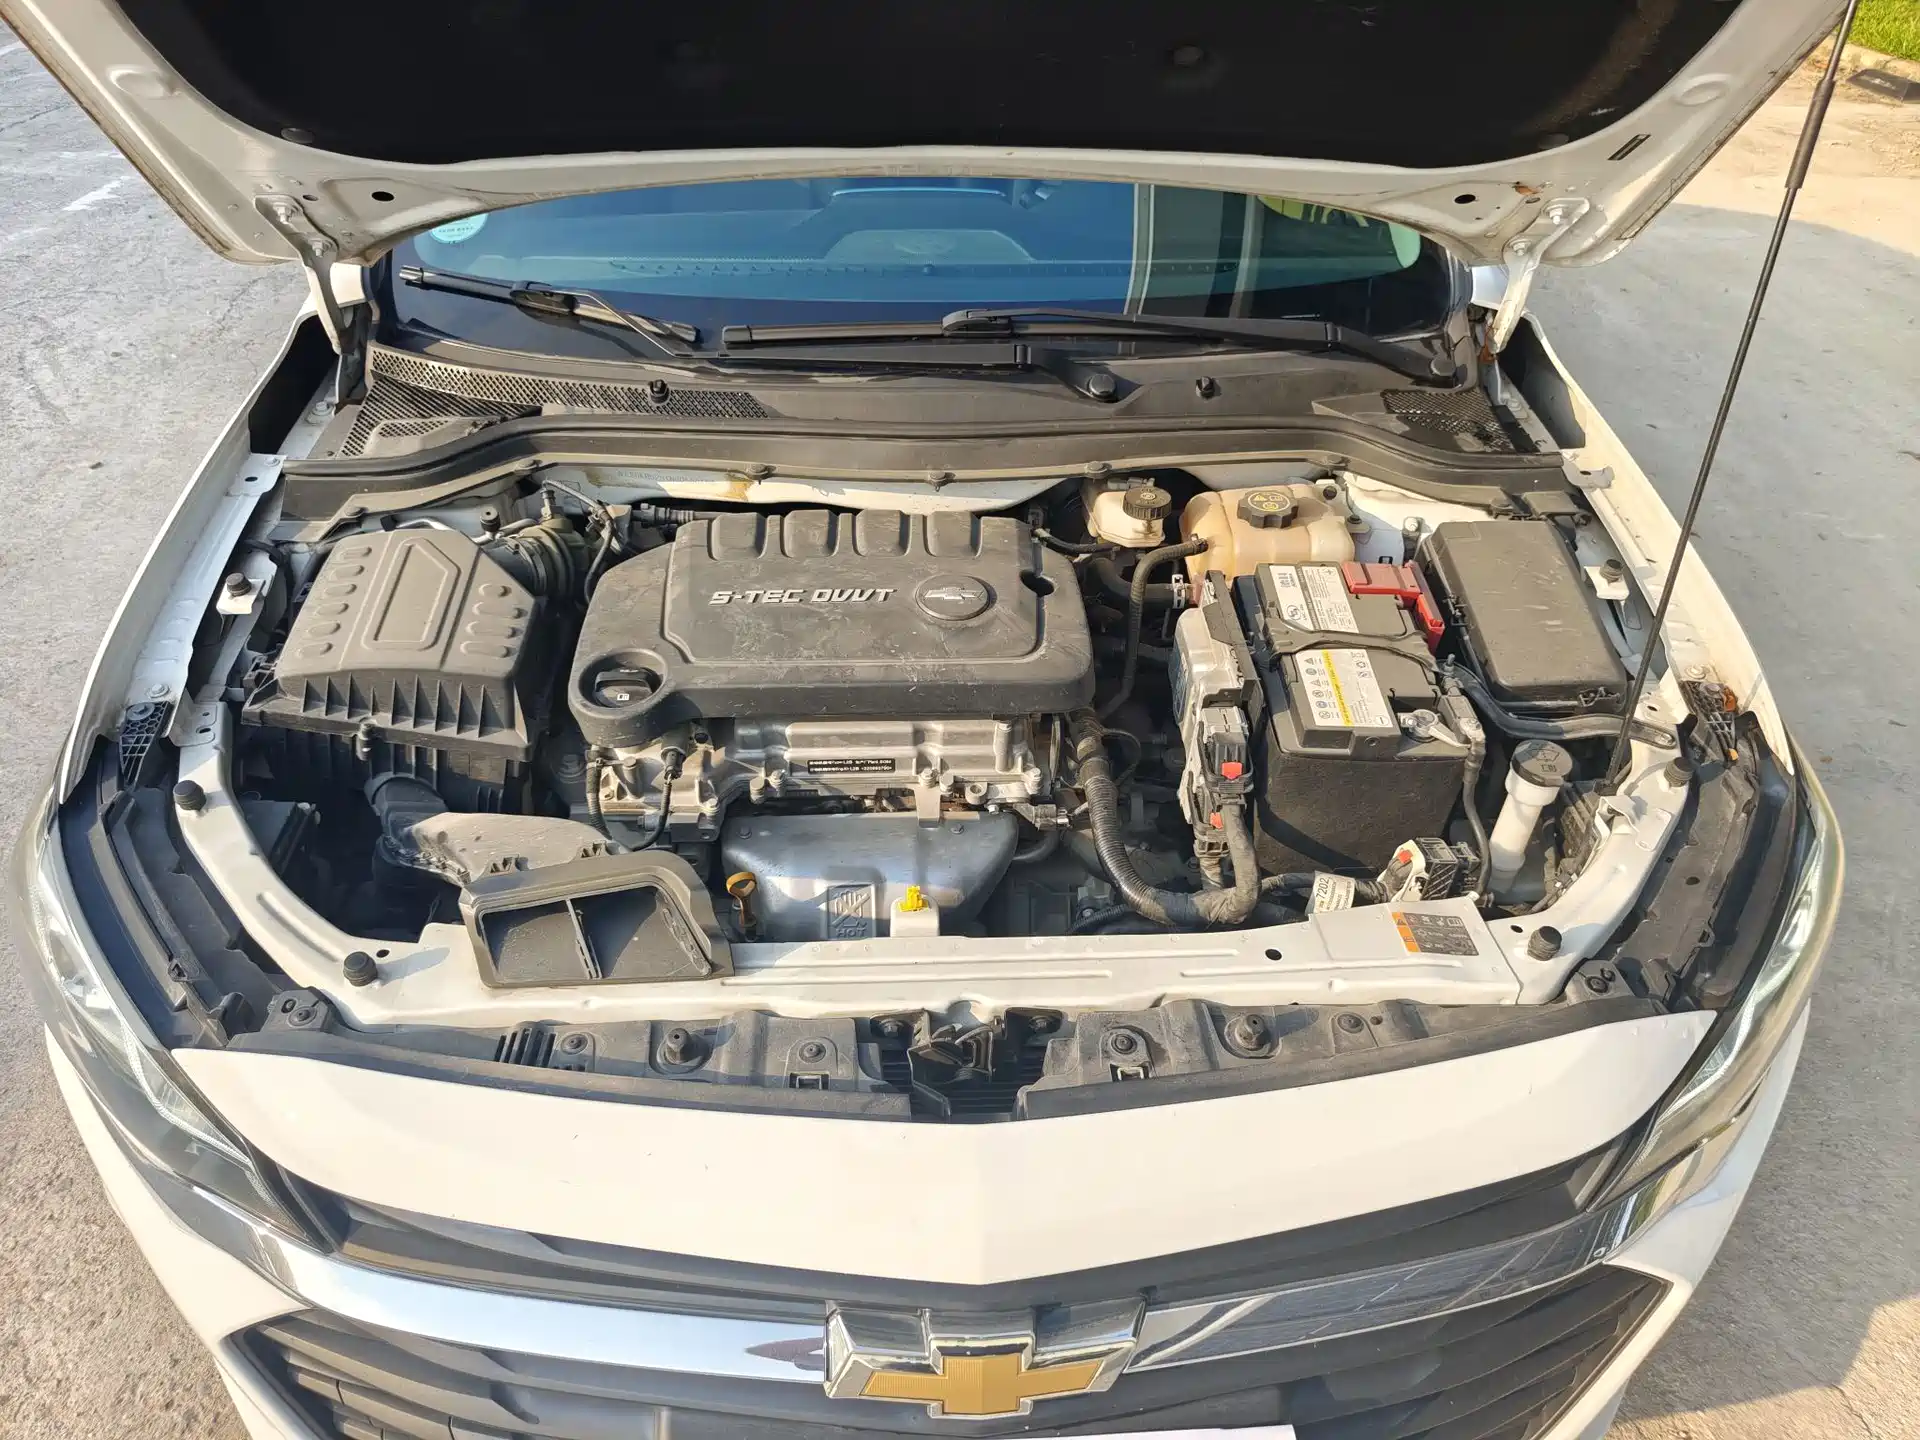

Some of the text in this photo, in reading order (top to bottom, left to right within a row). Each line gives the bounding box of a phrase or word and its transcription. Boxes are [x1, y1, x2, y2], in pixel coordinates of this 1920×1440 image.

[709, 588, 895, 605] S-TEC DVVT
[1316, 877, 1330, 899] 7202
[835, 927, 867, 938] HOT
